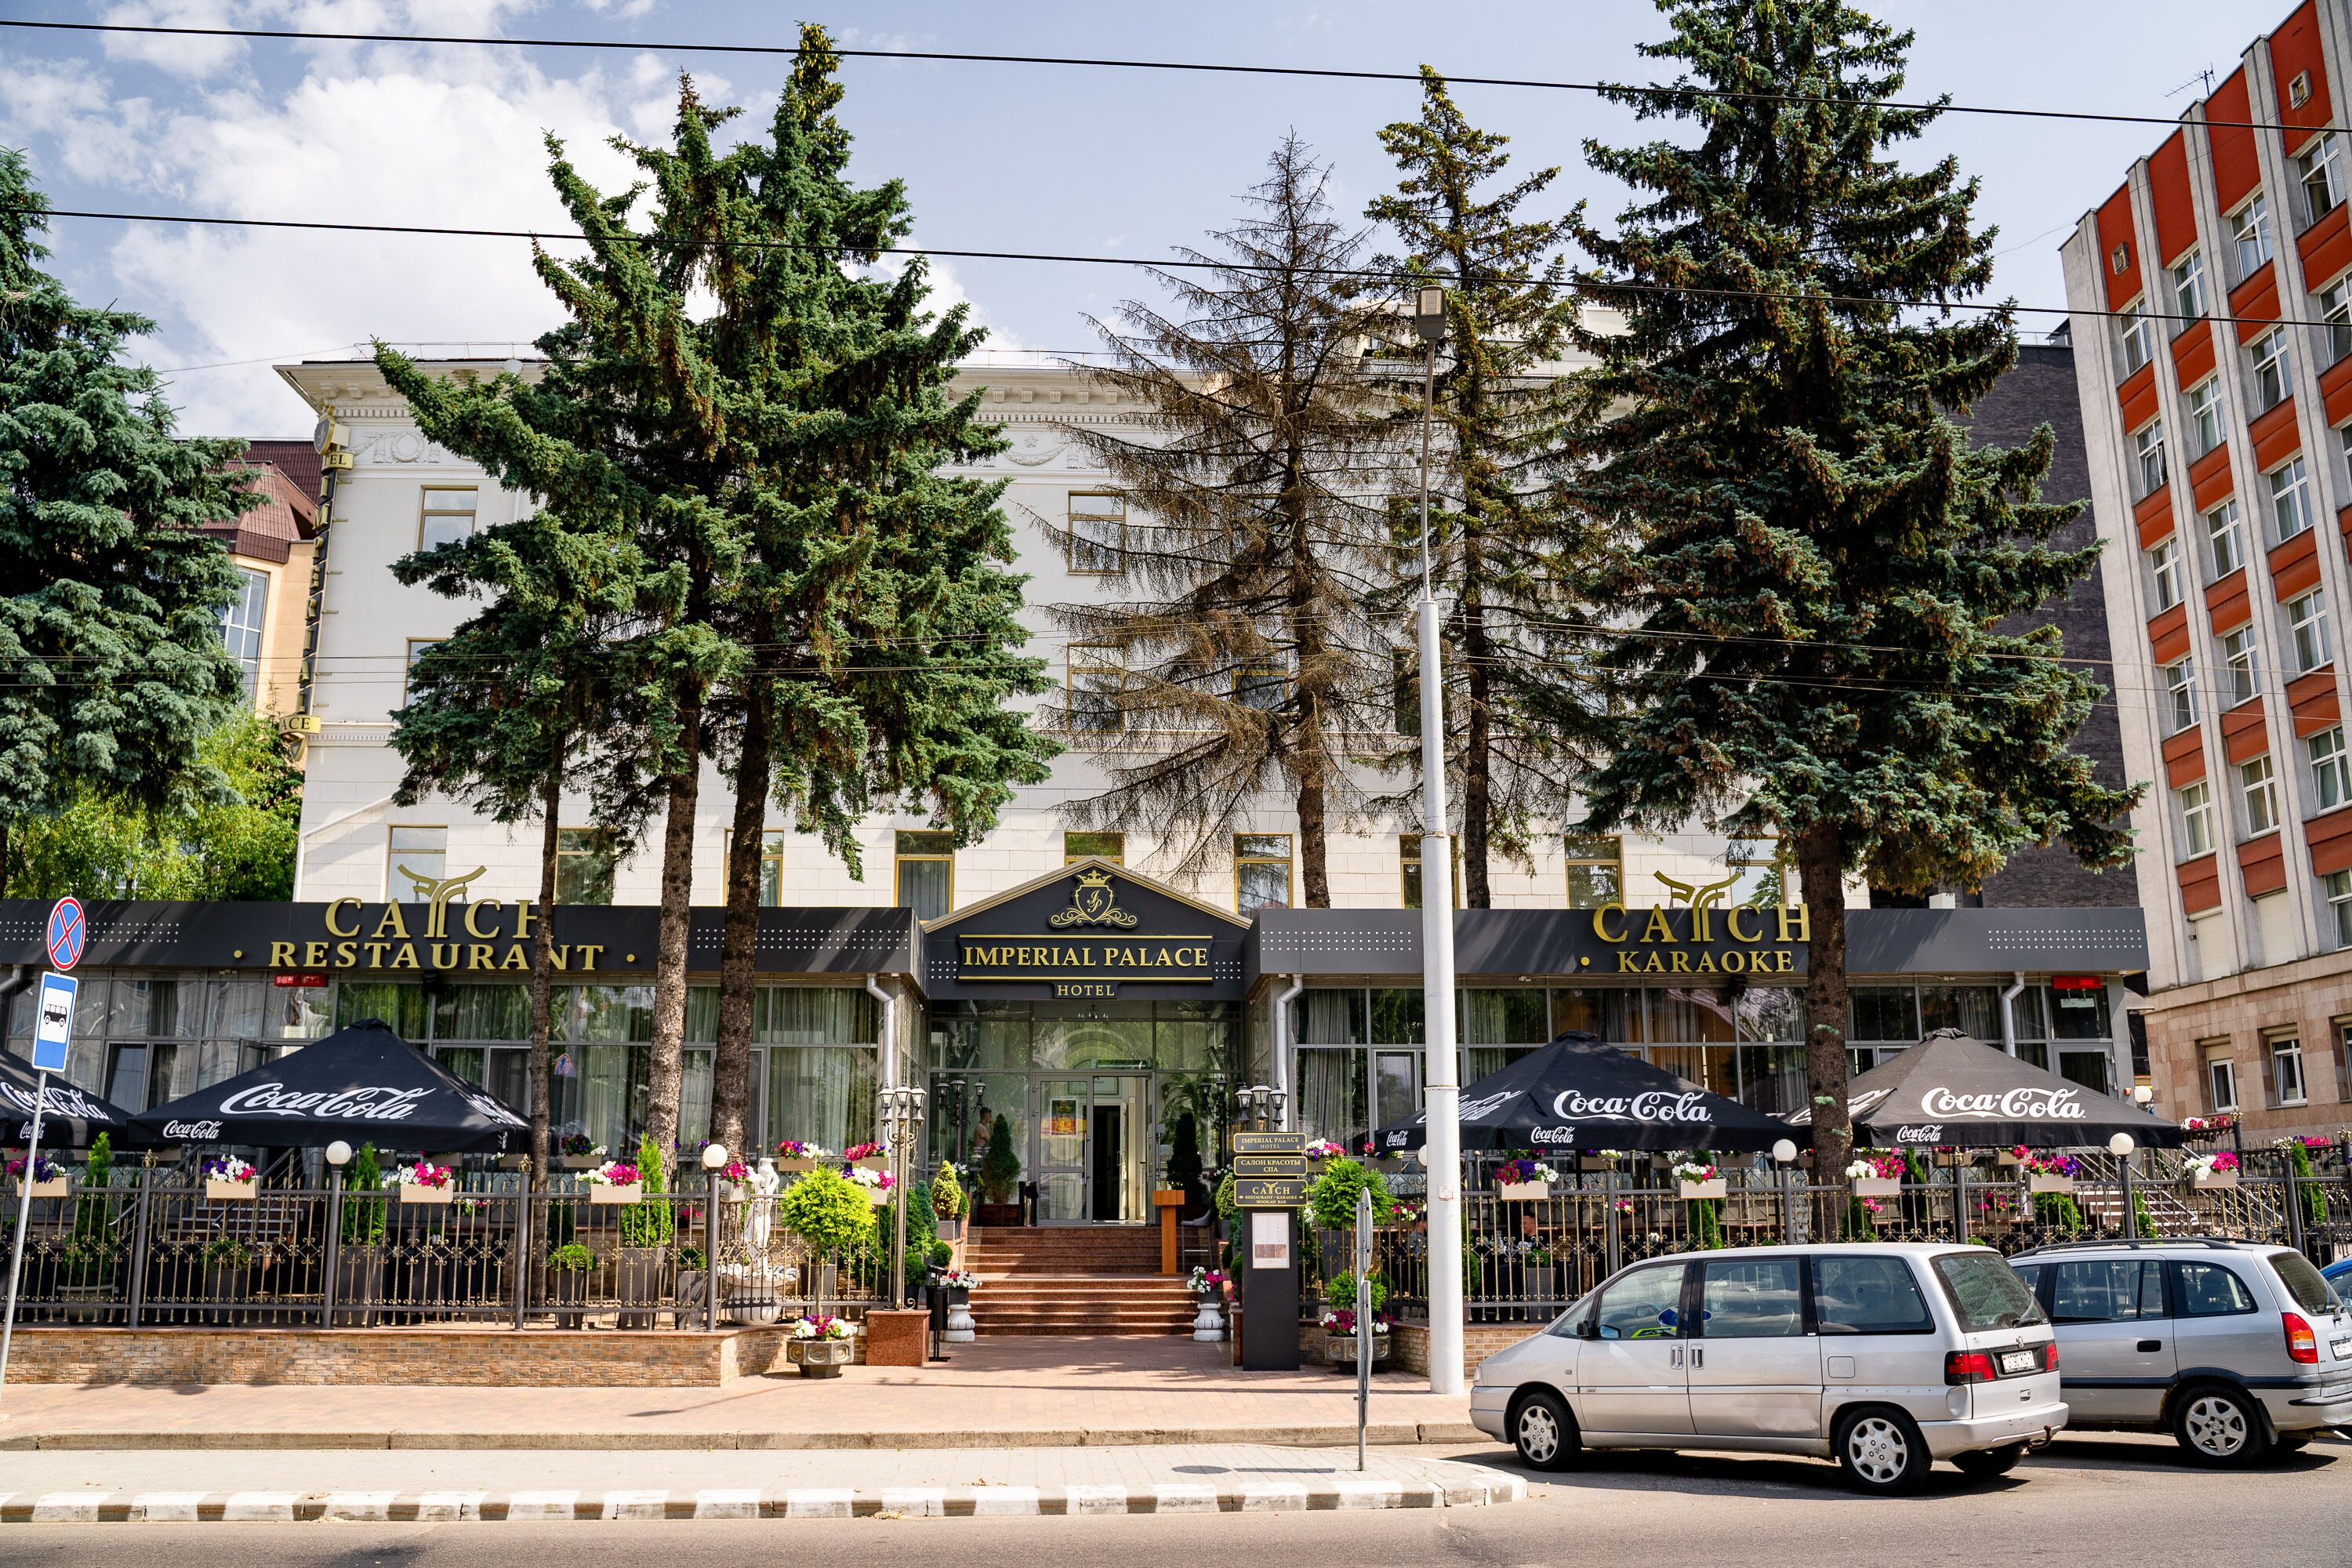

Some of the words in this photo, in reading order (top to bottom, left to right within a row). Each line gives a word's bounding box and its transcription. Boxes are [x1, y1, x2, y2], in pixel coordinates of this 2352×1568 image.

[1593, 870, 1810, 942] CATCH
[269, 942, 604, 971] RESTAURANT
[964, 947, 1096, 966] IMPERIAL
[1104, 947, 1208, 967] PALACE
[1617, 950, 1795, 973] KARAOKE
[1057, 985, 1115, 996] HOTEL
[220, 1083, 437, 1120] Coca-Cola
[1553, 1090, 1713, 1121] Coca-Cola
[1921, 1087, 2086, 1119] Coca-Cola
[163, 1120, 223, 1139] Coca-Cola
[1531, 1126, 1575, 1144] Coca-Cola
[1896, 1125, 1943, 1143] Coca-Cola
[1252, 1181, 1290, 1195] CATCH
